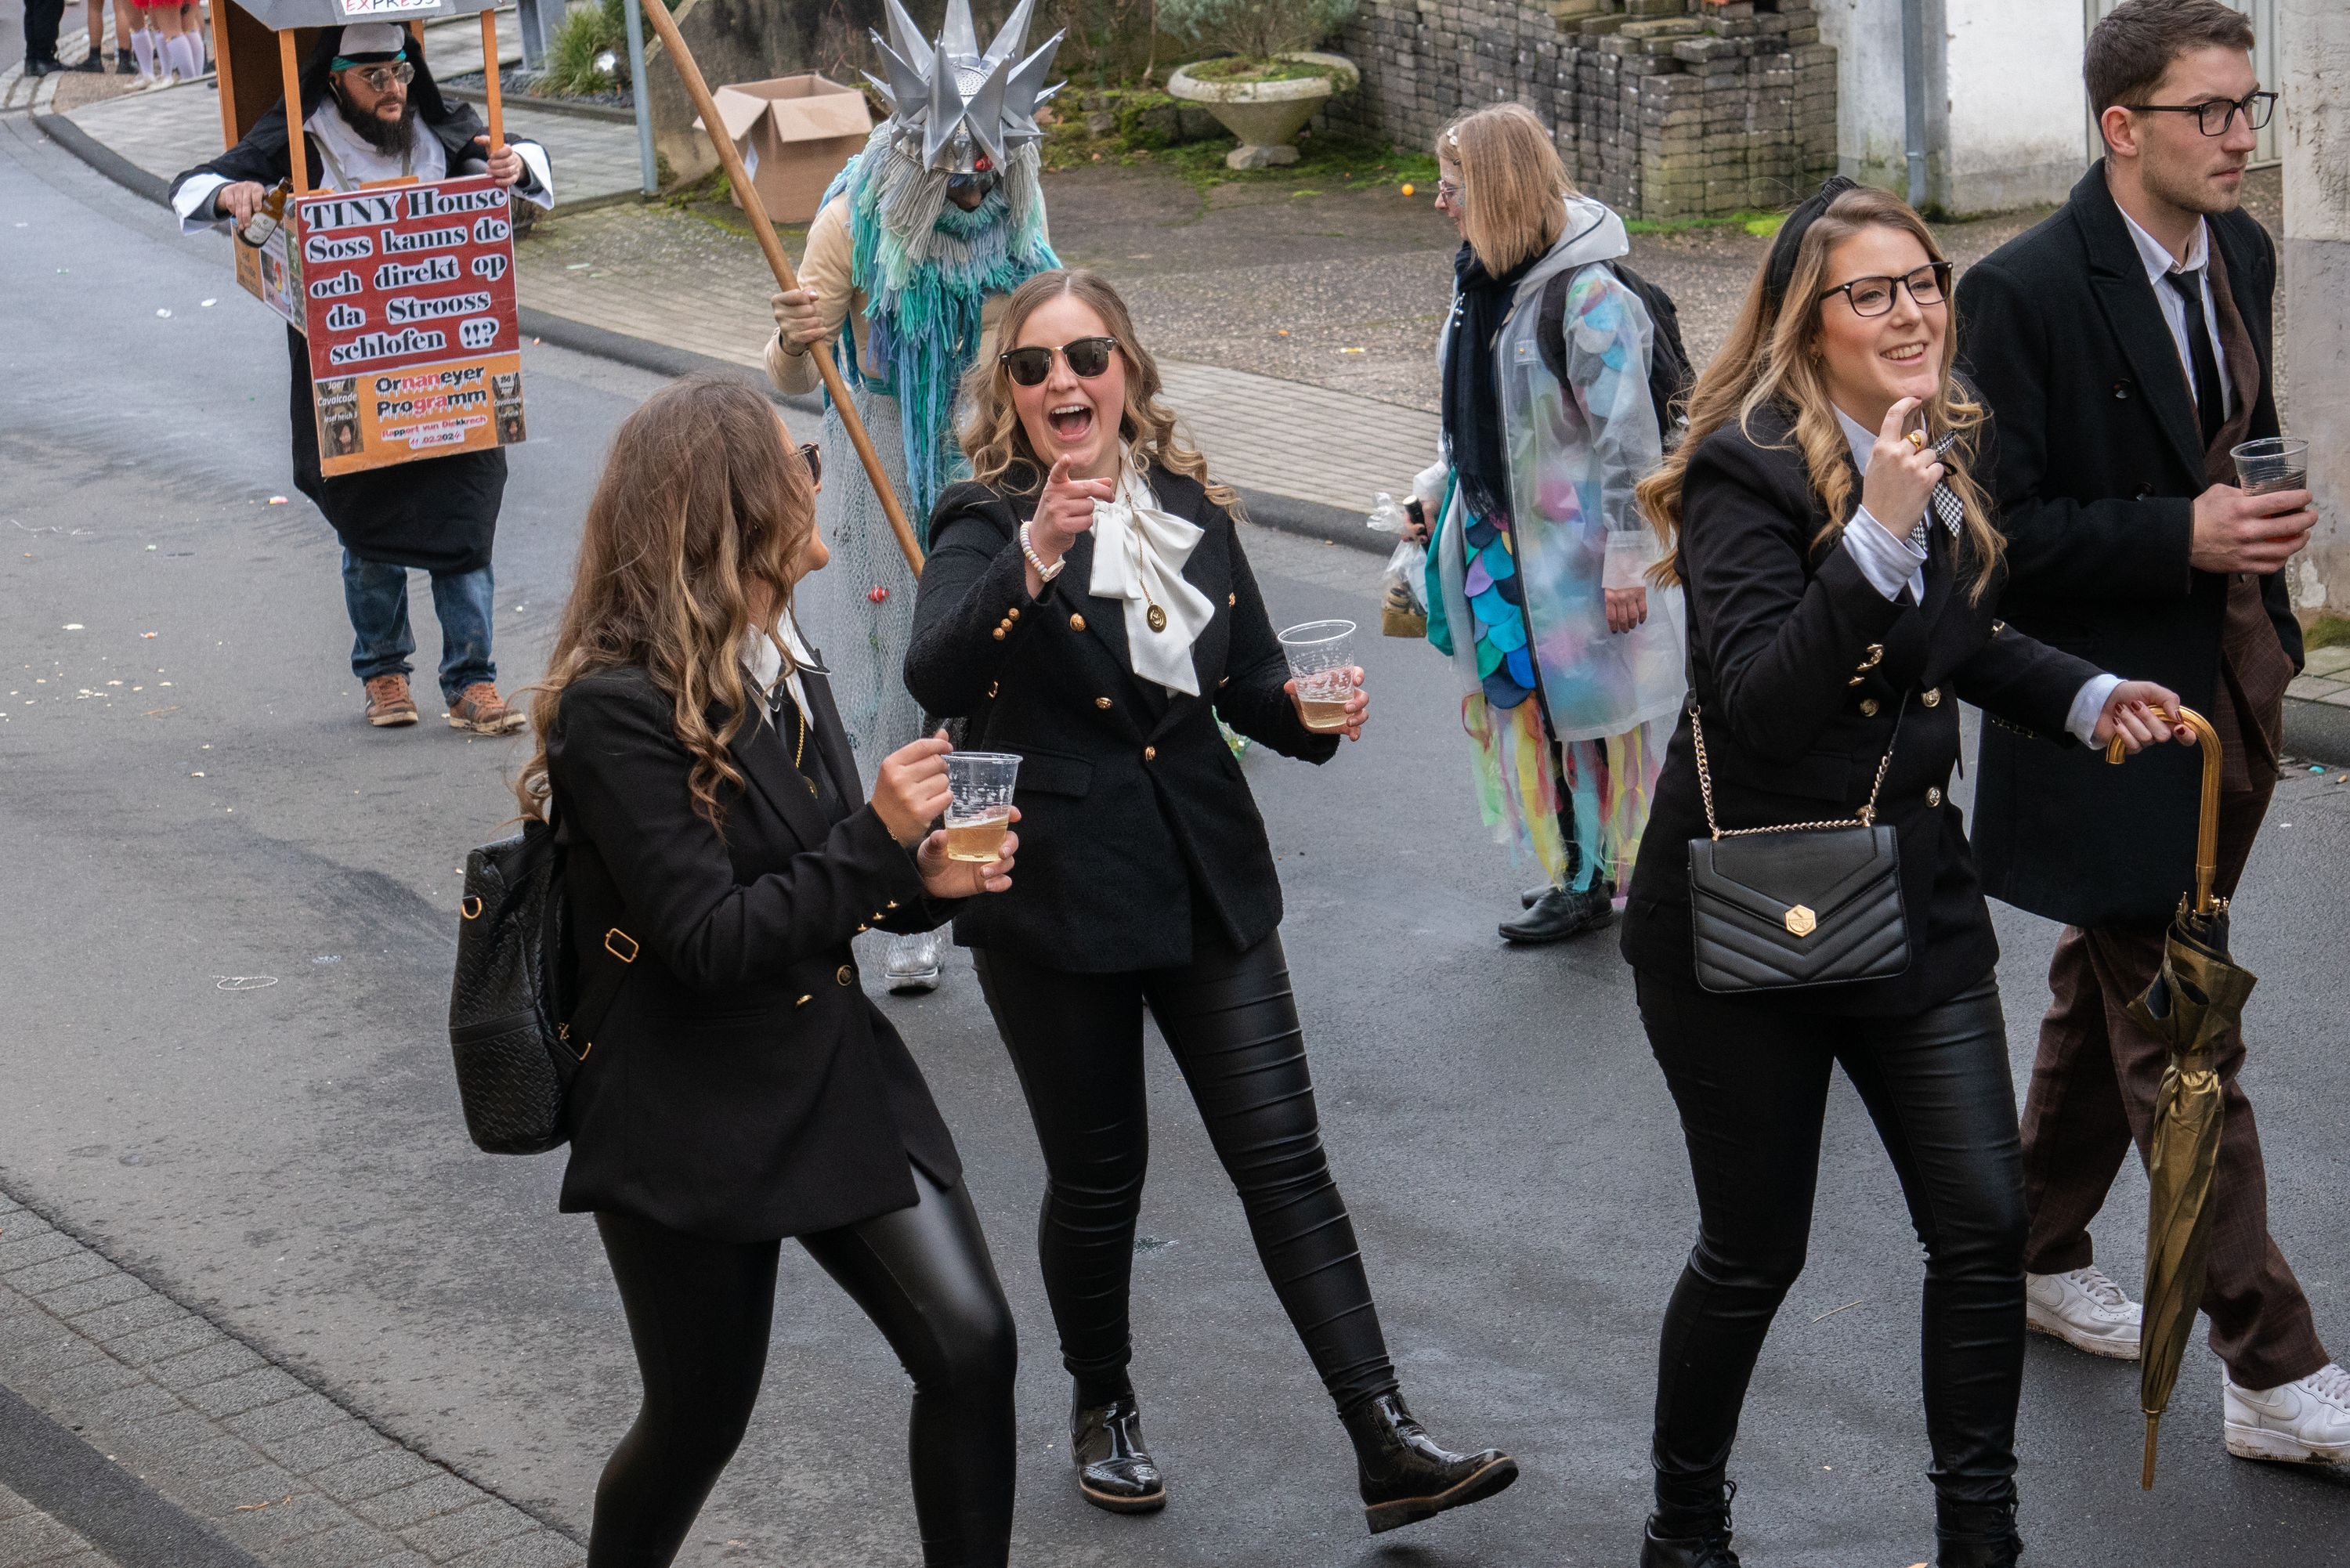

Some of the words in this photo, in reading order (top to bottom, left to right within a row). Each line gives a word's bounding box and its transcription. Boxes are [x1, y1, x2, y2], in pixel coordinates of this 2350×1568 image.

[305, 195, 398, 229] TINY
[409, 190, 506, 218] House
[309, 237, 371, 261] Soss
[384, 230, 466, 252] kanns
[475, 219, 507, 241] de
[313, 273, 361, 297] och
[374, 258, 458, 289] direkt
[474, 255, 506, 279] op
[329, 305, 363, 327] da
[389, 293, 489, 320] Strooss
[331, 330, 445, 363] schlofen
[375, 367, 484, 393] Ornaneyer
[317, 392, 357, 406] Cavalcade
[377, 389, 486, 417] Programm
[423, 423, 439, 432] vun
